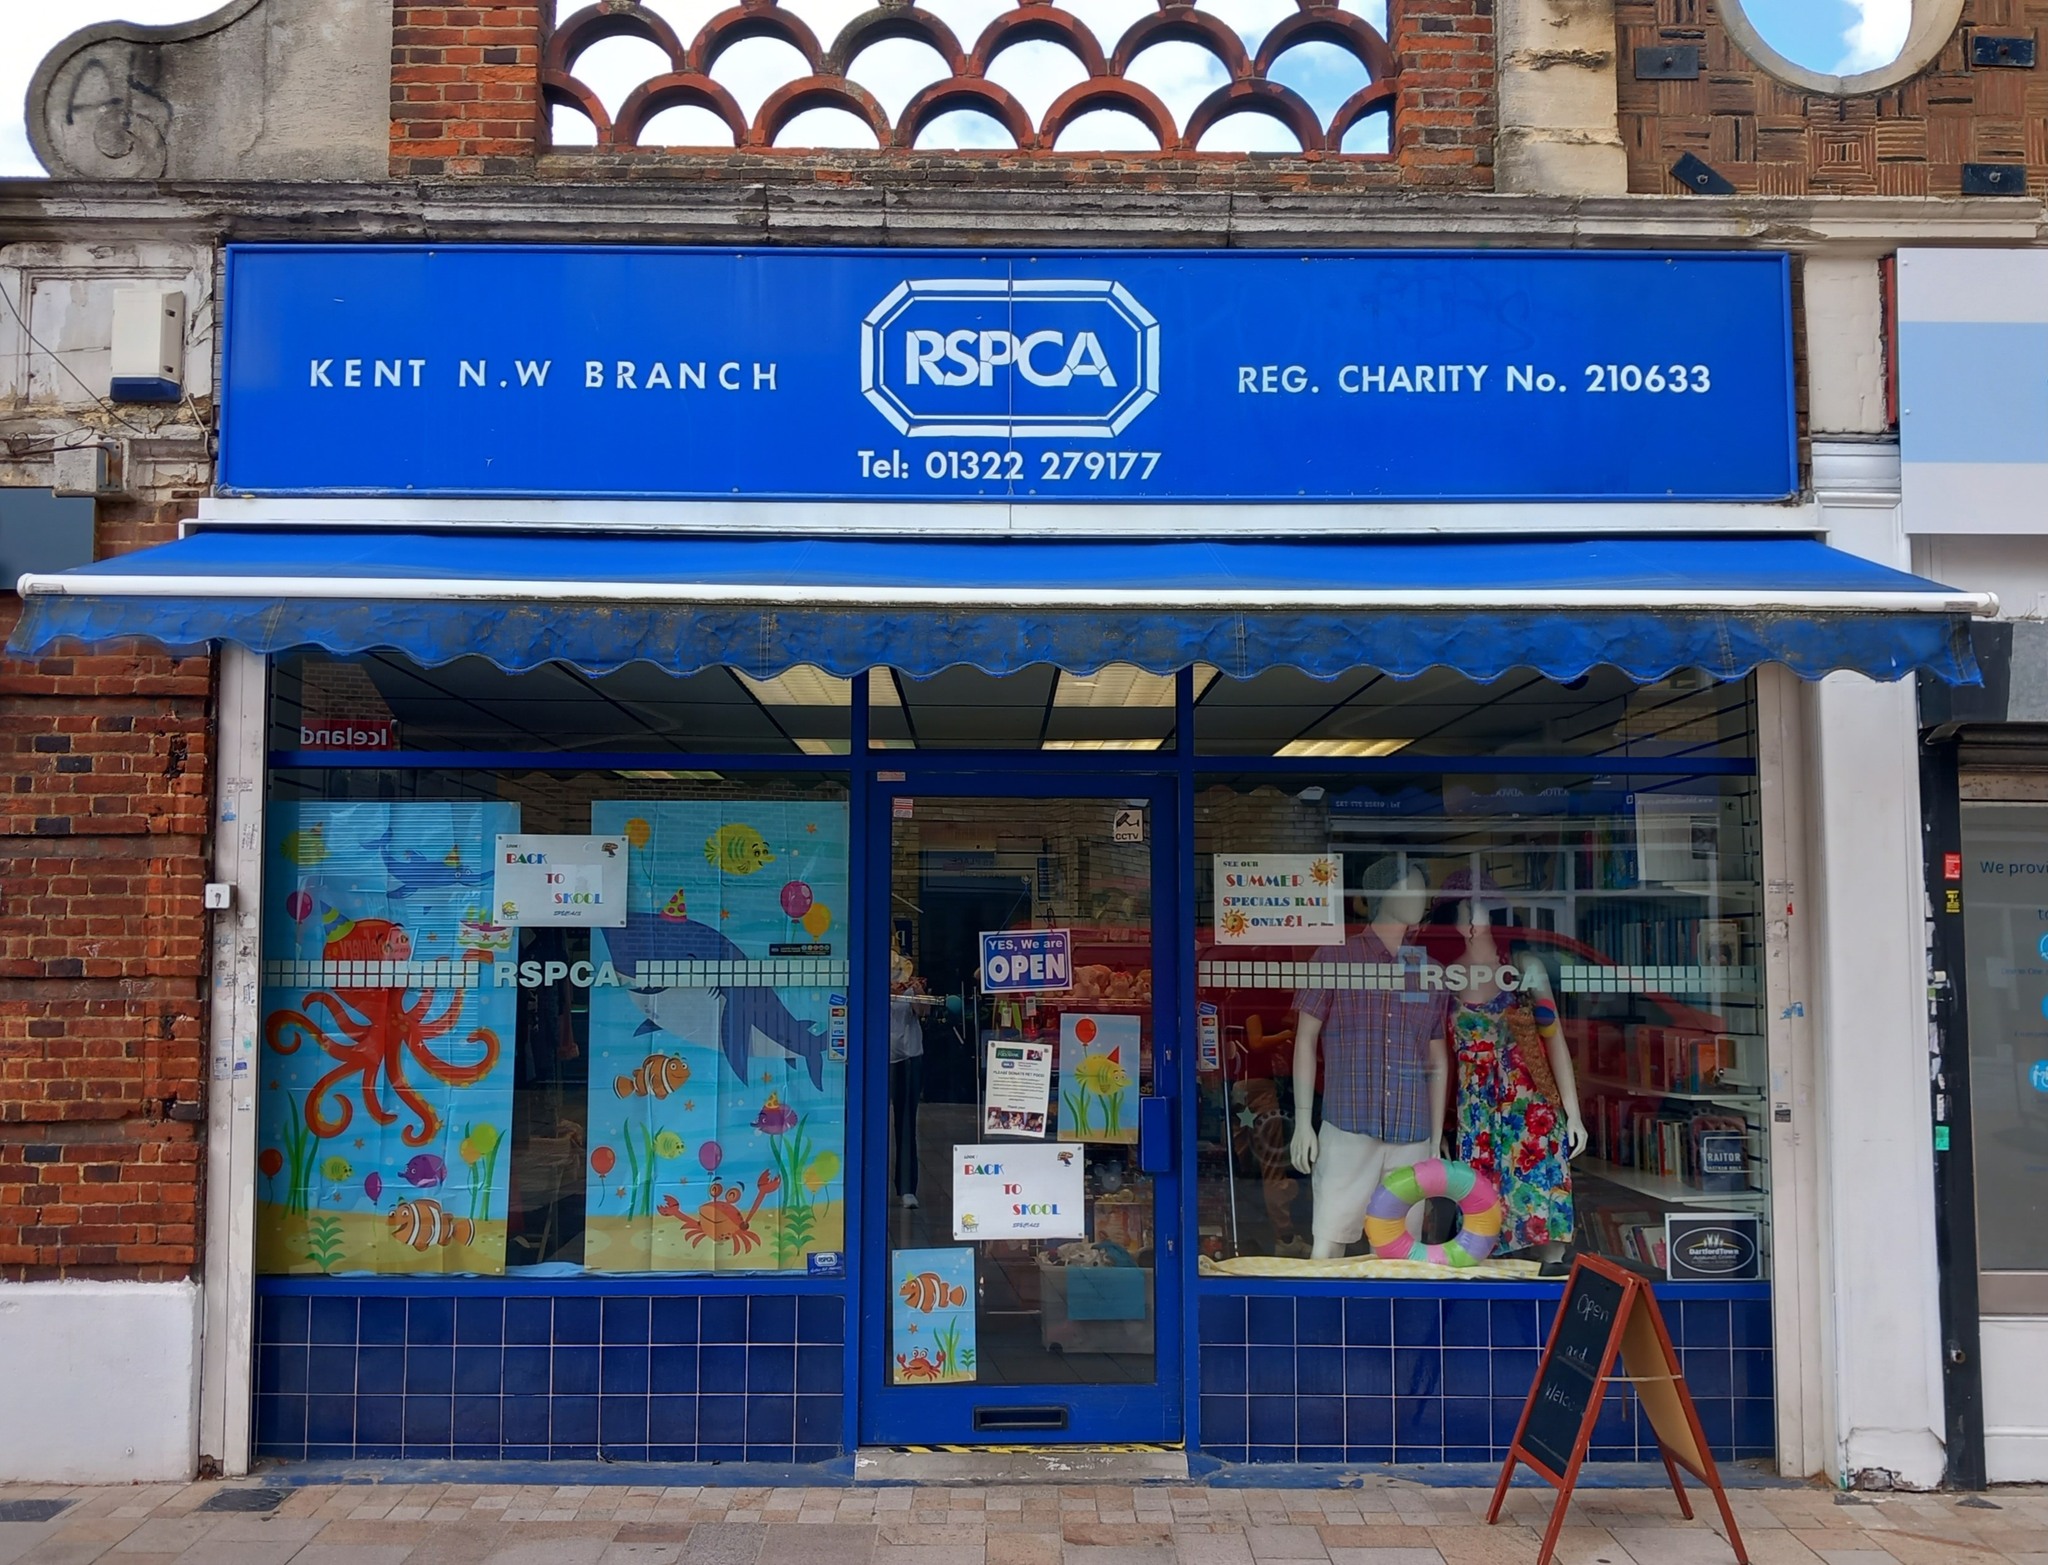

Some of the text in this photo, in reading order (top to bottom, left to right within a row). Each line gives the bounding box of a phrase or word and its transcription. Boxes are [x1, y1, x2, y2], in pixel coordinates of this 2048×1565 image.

[906, 330, 1118, 387] RSPCA
[311, 360, 776, 389] KENT N.W BRANCH
[1239, 365, 1710, 392] REG. CHARITY No. 210633
[857, 450, 1162, 480] Tel: 01322 279177
[1115, 832, 1140, 841] CCTV
[506, 853, 548, 864] BACK
[1980, 861, 2004, 874] We
[545, 873, 566, 884] TO
[1226, 873, 1305, 887] SUMMER
[554, 893, 604, 904] SKOOL
[1223, 896, 1329, 907] SPECIALS RAIL
[988, 939, 1063, 952] YES, We are
[493, 960, 620, 988] RSPCA
[988, 953, 1066, 983] OPEN
[1420, 964, 1545, 991] RSPCA
[964, 1164, 1005, 1175] BACK
[1003, 1183, 1022, 1195] TO
[1013, 1204, 1061, 1215] SKOOL
[1577, 1293, 1609, 1322] Open
